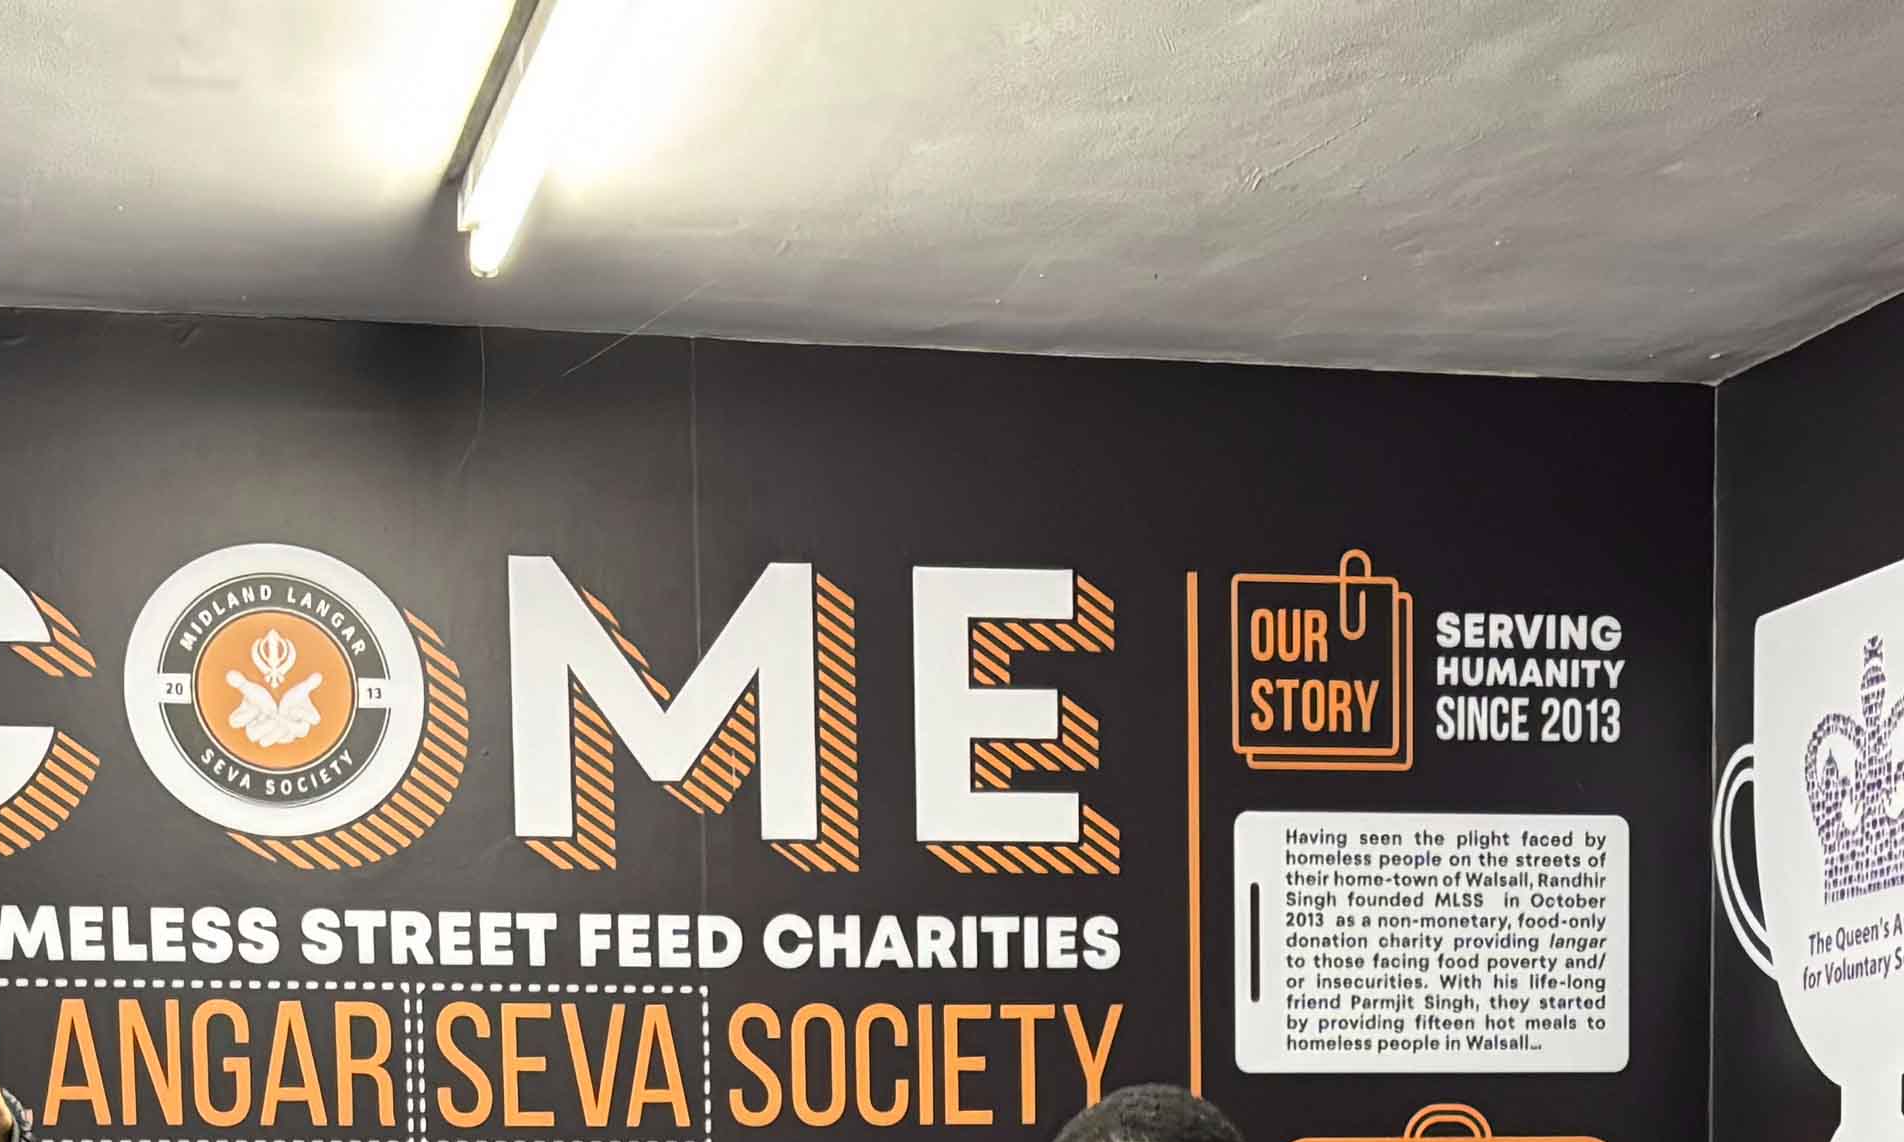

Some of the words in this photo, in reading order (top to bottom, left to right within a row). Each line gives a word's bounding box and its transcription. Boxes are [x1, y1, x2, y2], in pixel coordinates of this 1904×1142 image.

[179, 584, 272, 652] MIDLAND
[287, 587, 366, 656] LANGAR
[1251, 608, 1328, 662] OUR
[1436, 612, 1622, 651] SERVING
[165, 681, 184, 696] 20
[1437, 656, 1625, 688] HUMANITY
[367, 686, 383, 700] 13
[1251, 678, 1379, 732] STORY
[1436, 696, 1529, 741] SINCE
[1541, 697, 1620, 743] 2013
[200, 748, 252, 789] SEVA
[265, 749, 354, 796] SOCIETY
[1286, 828, 1347, 848] Having
[1360, 833, 1402, 846] seen
[1414, 829, 1445, 846] the
[1457, 830, 1510, 850] plight
[1522, 831, 1573, 847] faced
[1585, 831, 1606, 851] by
[1286, 849, 1371, 866] homeless
[1379, 850, 1442, 870] people
[1449, 855, 1471, 867] on
[1478, 851, 1508, 867] the
[1516, 854, 1581, 868] streets
[1588, 852, 1606, 868] of
[1286, 870, 1329, 886] their
[1334, 870, 1438, 887] home-town
[1442, 871, 1461, 887] of
[1466, 871, 1533, 890] Walsall,
[1538, 872, 1606, 888] Randhir
[1286, 891, 1336, 911] Singh
[1347, 891, 1424, 907] founded
[1435, 892, 1484, 908] MLSS
[1504, 892, 1520, 908] in
[1530, 893, 1606, 909] October
[301, 908, 557, 966] STREET
[579, 913, 743, 968] FEED
[763, 913, 1120, 969] CHARITIES
[1286, 912, 1324, 927] 2013
[1336, 915, 1355, 927] as
[1361, 916, 1371, 928] a
[1378, 914, 1511, 932] non-monetary,
[1518, 912, 1606, 932] food-only
[1808, 931, 1832, 956] The
[1836, 917, 1890, 951] Queen's
[1286, 932, 1368, 949] donation
[1379, 932, 1443, 952] charity
[1454, 932, 1539, 952] providing
[1549, 933, 1607, 952] langar
[1286, 954, 1305, 968] to
[1313, 953, 1365, 968] those
[1373, 953, 1429, 972] facing
[1438, 953, 1479, 969] food
[1487, 955, 1558, 973] poverty
[1565, 952, 1606, 970] and/
[1803, 966, 1822, 991] for
[1825, 955, 1891, 985] Voluntary
[435, 1001, 690, 1128] SEVA
[729, 1003, 1122, 1126] SOCIETY
